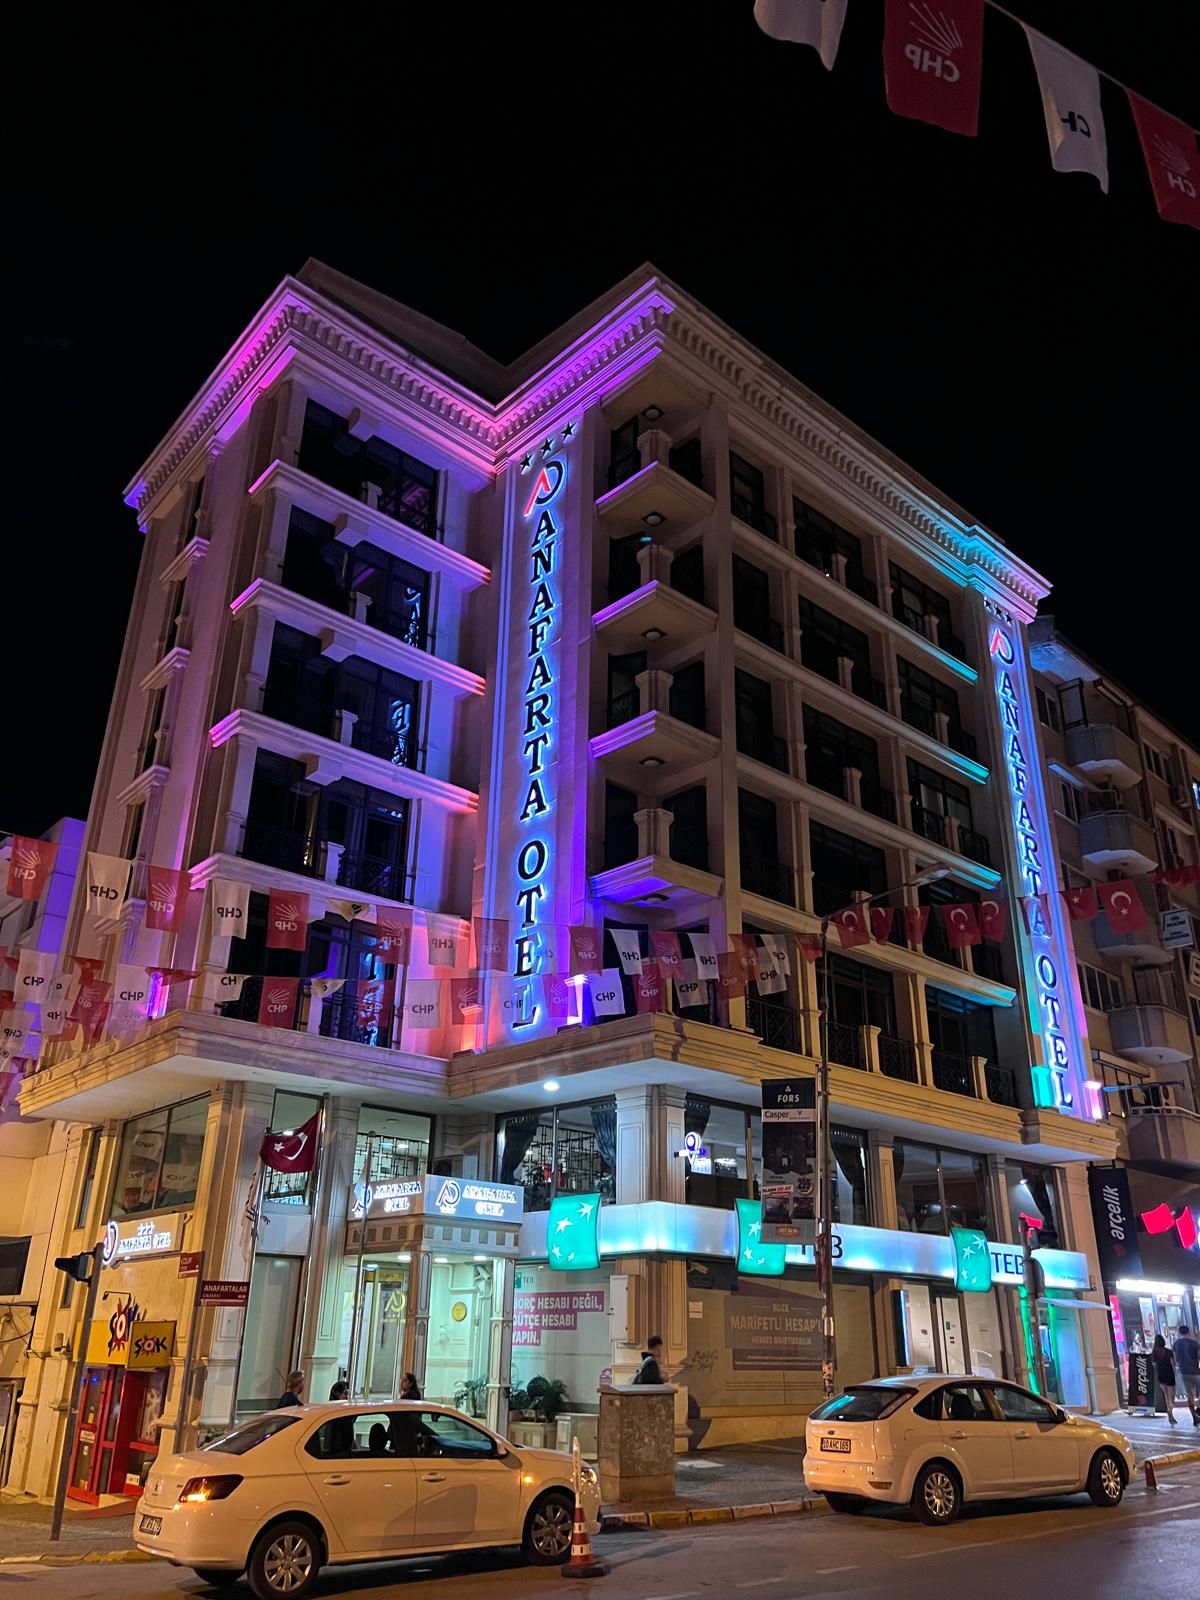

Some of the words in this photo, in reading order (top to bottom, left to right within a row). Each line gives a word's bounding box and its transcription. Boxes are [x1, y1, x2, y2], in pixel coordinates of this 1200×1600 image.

[519, 509, 556, 822] ANAFARTA
[998, 671, 1050, 940] ANAFARTA
[1035, 954, 1074, 1109] OTEL
[511, 838, 547, 1031] OTEL
[760, 969, 778, 980] CHP
[23, 976, 45, 986] CHP
[220, 976, 237, 986] CH
[641, 988, 658, 998] CHP
[679, 982, 699, 993] CHP
[120, 991, 144, 1001] CHP
[595, 991, 616, 1002] CHP
[267, 1004, 288, 1014] CHP
[412, 1004, 434, 1014] CHP
[777, 1094, 800, 1104] FORS
[765, 1110, 790, 1119] Casper
[1103, 1184, 1125, 1241] arçelik
[537, 1296, 570, 1310] HESABI
[541, 1314, 575, 1327] HESABI
[785, 1317, 824, 1333] HESAP'L
[1135, 1354, 1149, 1395] arçelik
